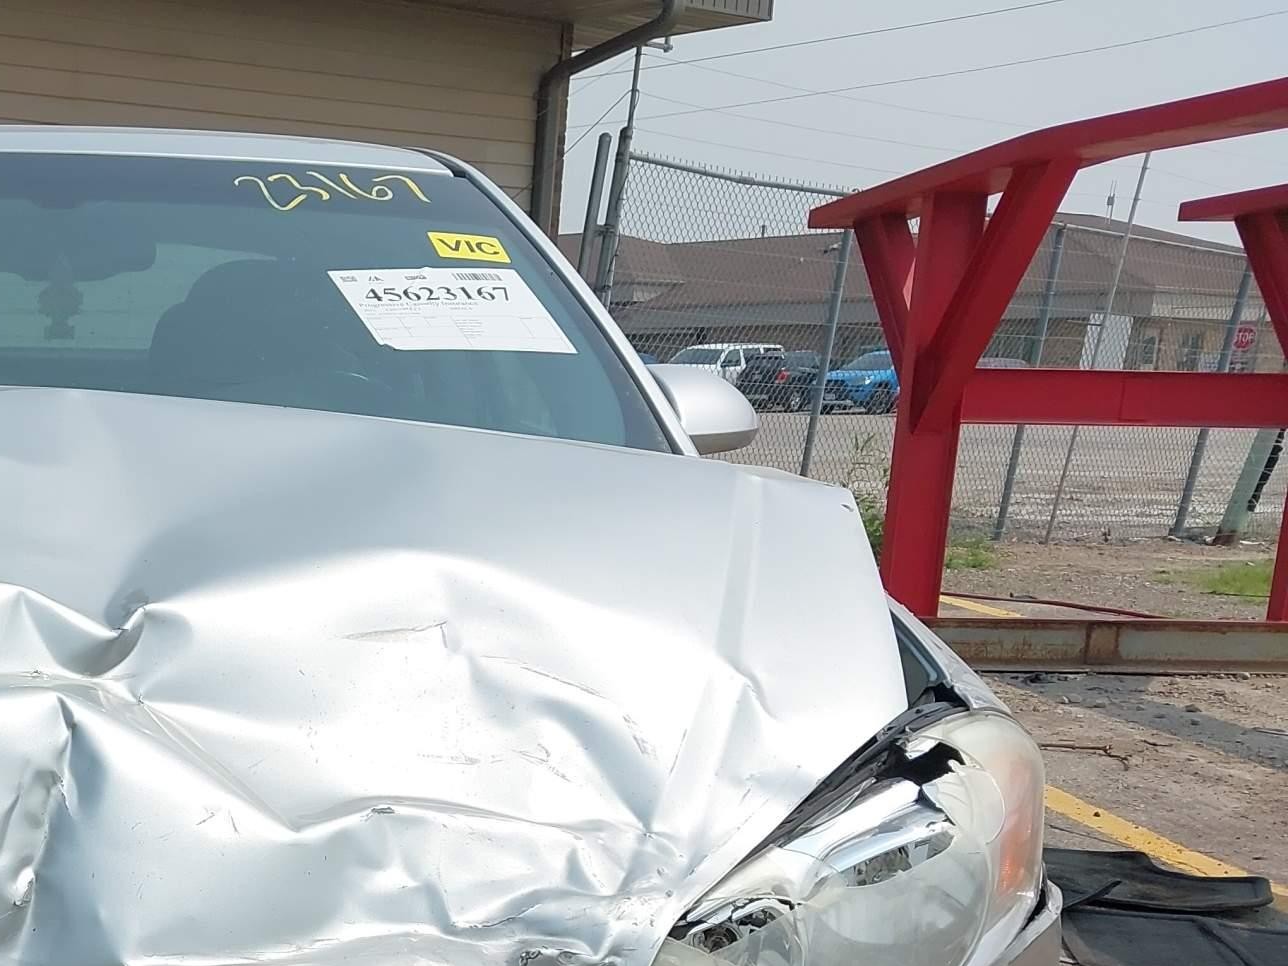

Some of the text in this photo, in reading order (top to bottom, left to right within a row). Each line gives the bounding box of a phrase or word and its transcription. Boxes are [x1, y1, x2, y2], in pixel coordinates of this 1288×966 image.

[234, 171, 432, 211] 23167
[437, 237, 501, 256] VIC
[365, 285, 510, 302] 45623167
